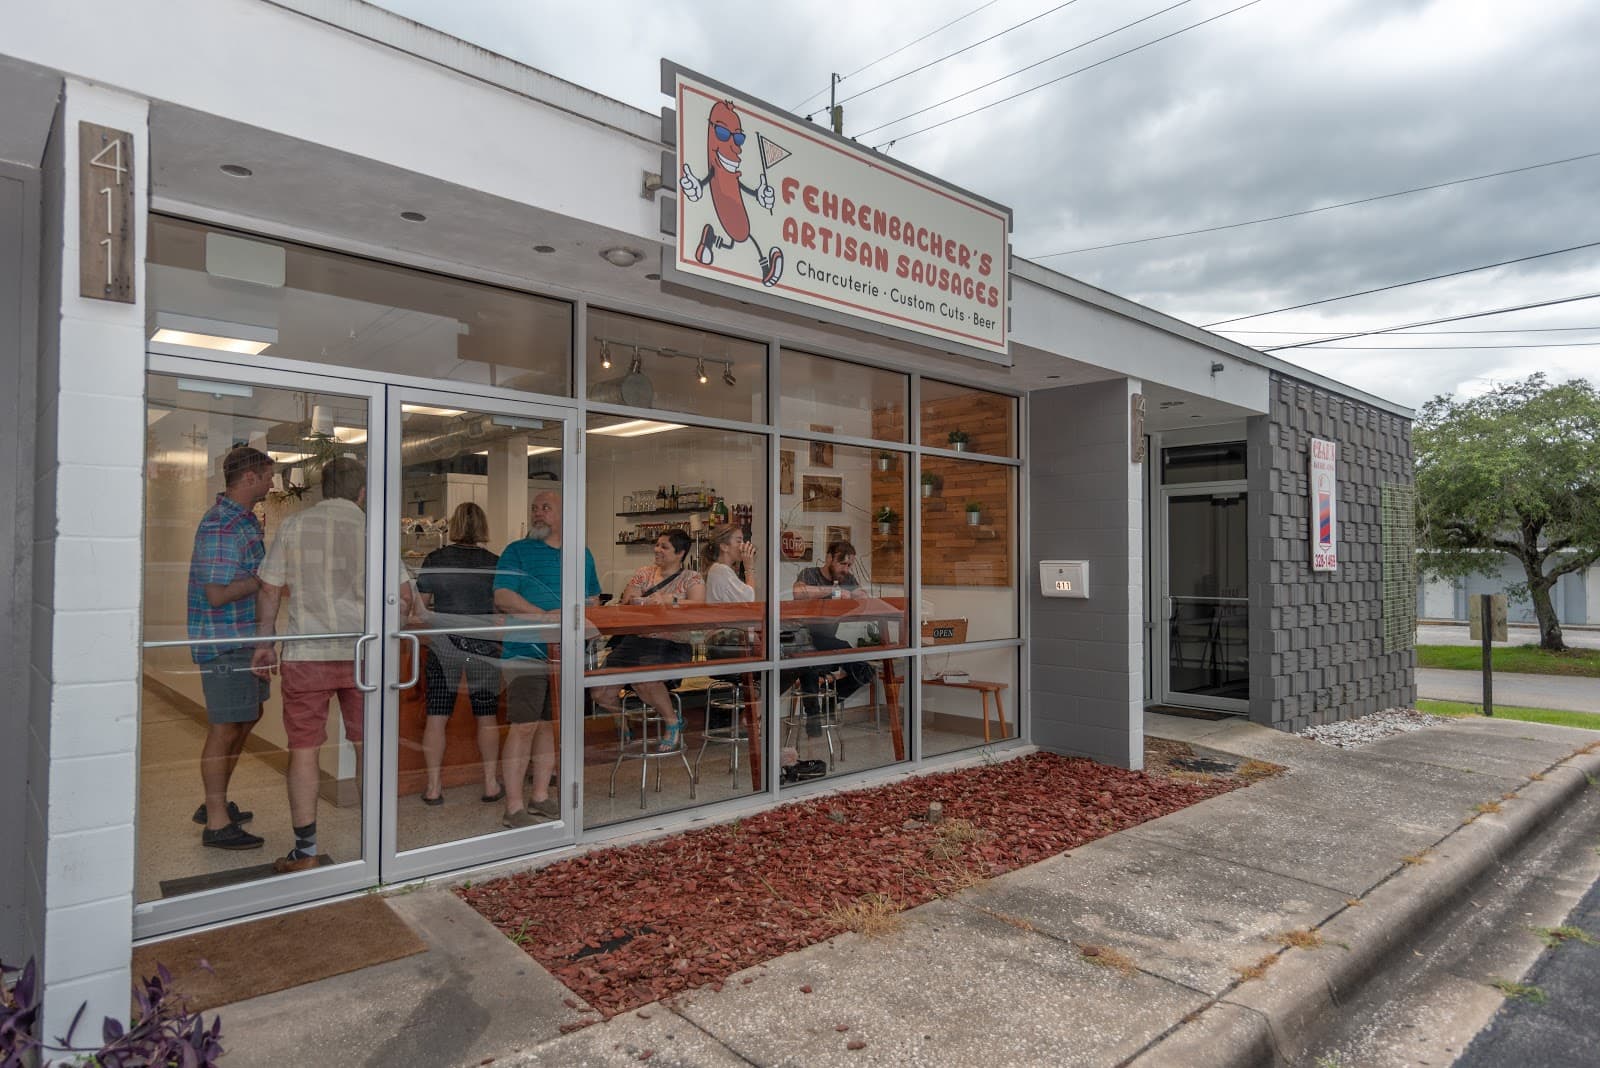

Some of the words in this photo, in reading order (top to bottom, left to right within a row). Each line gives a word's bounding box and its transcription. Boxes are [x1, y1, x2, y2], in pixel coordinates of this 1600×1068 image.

[90, 138, 128, 285] 411
[782, 176, 993, 276] FEHRENBACHER'S
[782, 217, 888, 272] ARTISAN
[896, 254, 999, 308] SAUSAGES
[796, 260, 879, 297] Charcuterie
[890, 288, 935, 313] Custom
[940, 302, 965, 321] Cuts
[973, 312, 996, 330] Beer
[1056, 582, 1070, 590] 411
[933, 629, 953, 638] OPEN
